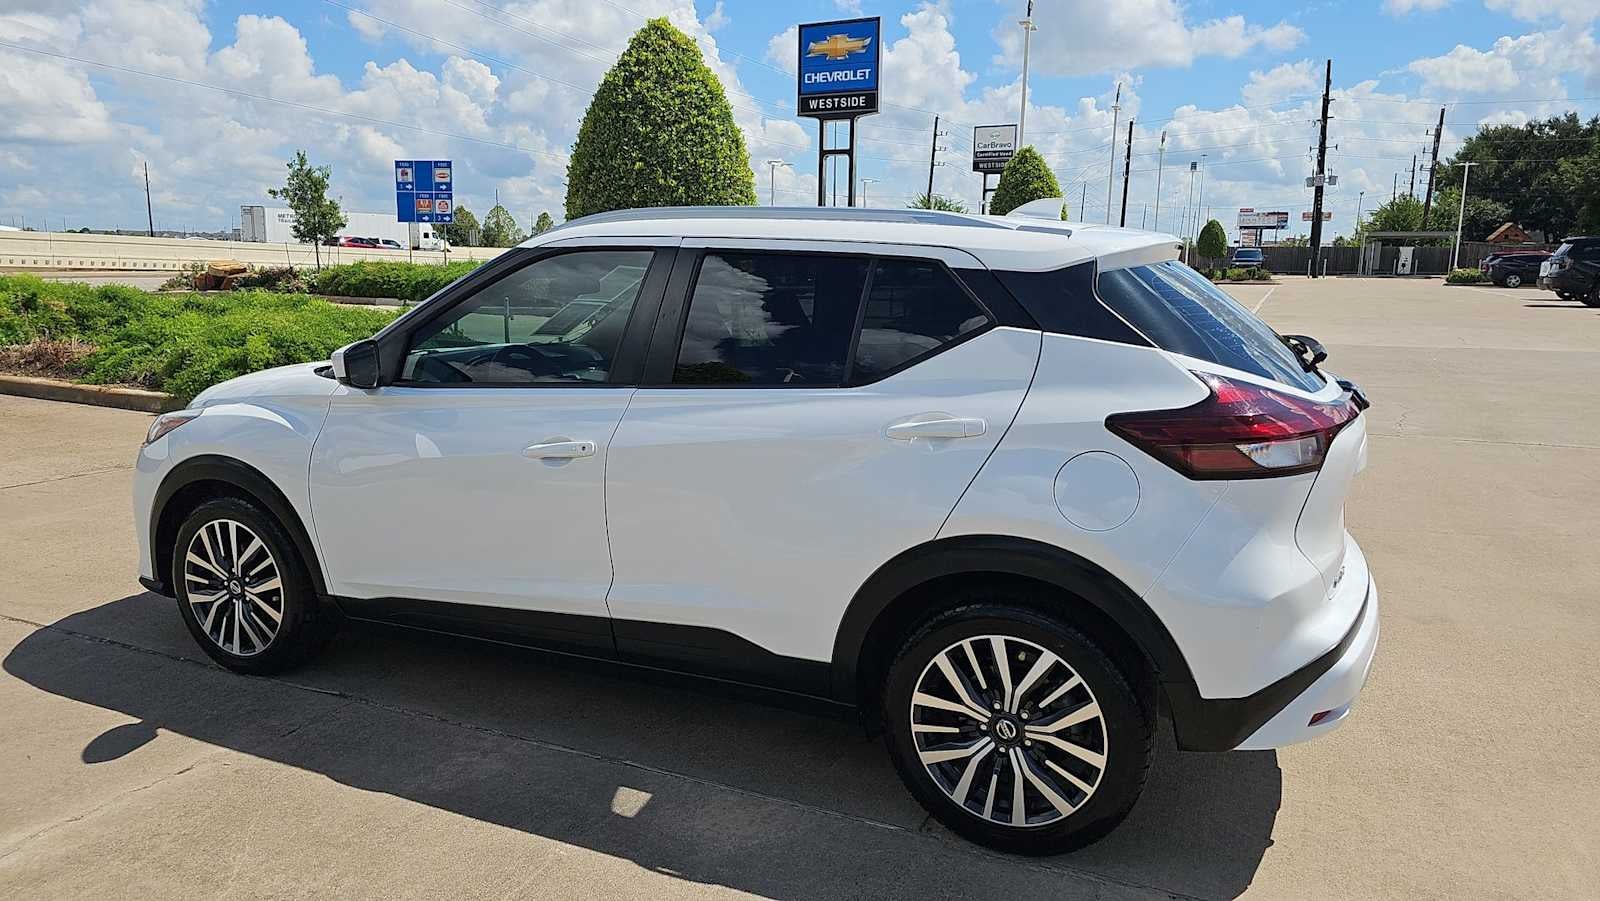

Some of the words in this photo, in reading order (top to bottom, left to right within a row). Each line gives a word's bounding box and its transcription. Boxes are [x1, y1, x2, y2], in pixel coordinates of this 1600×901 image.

[804, 68, 871, 83] CHEVROLET
[809, 96, 867, 109] WESTSIDE
[977, 141, 1012, 149] CarBravo
